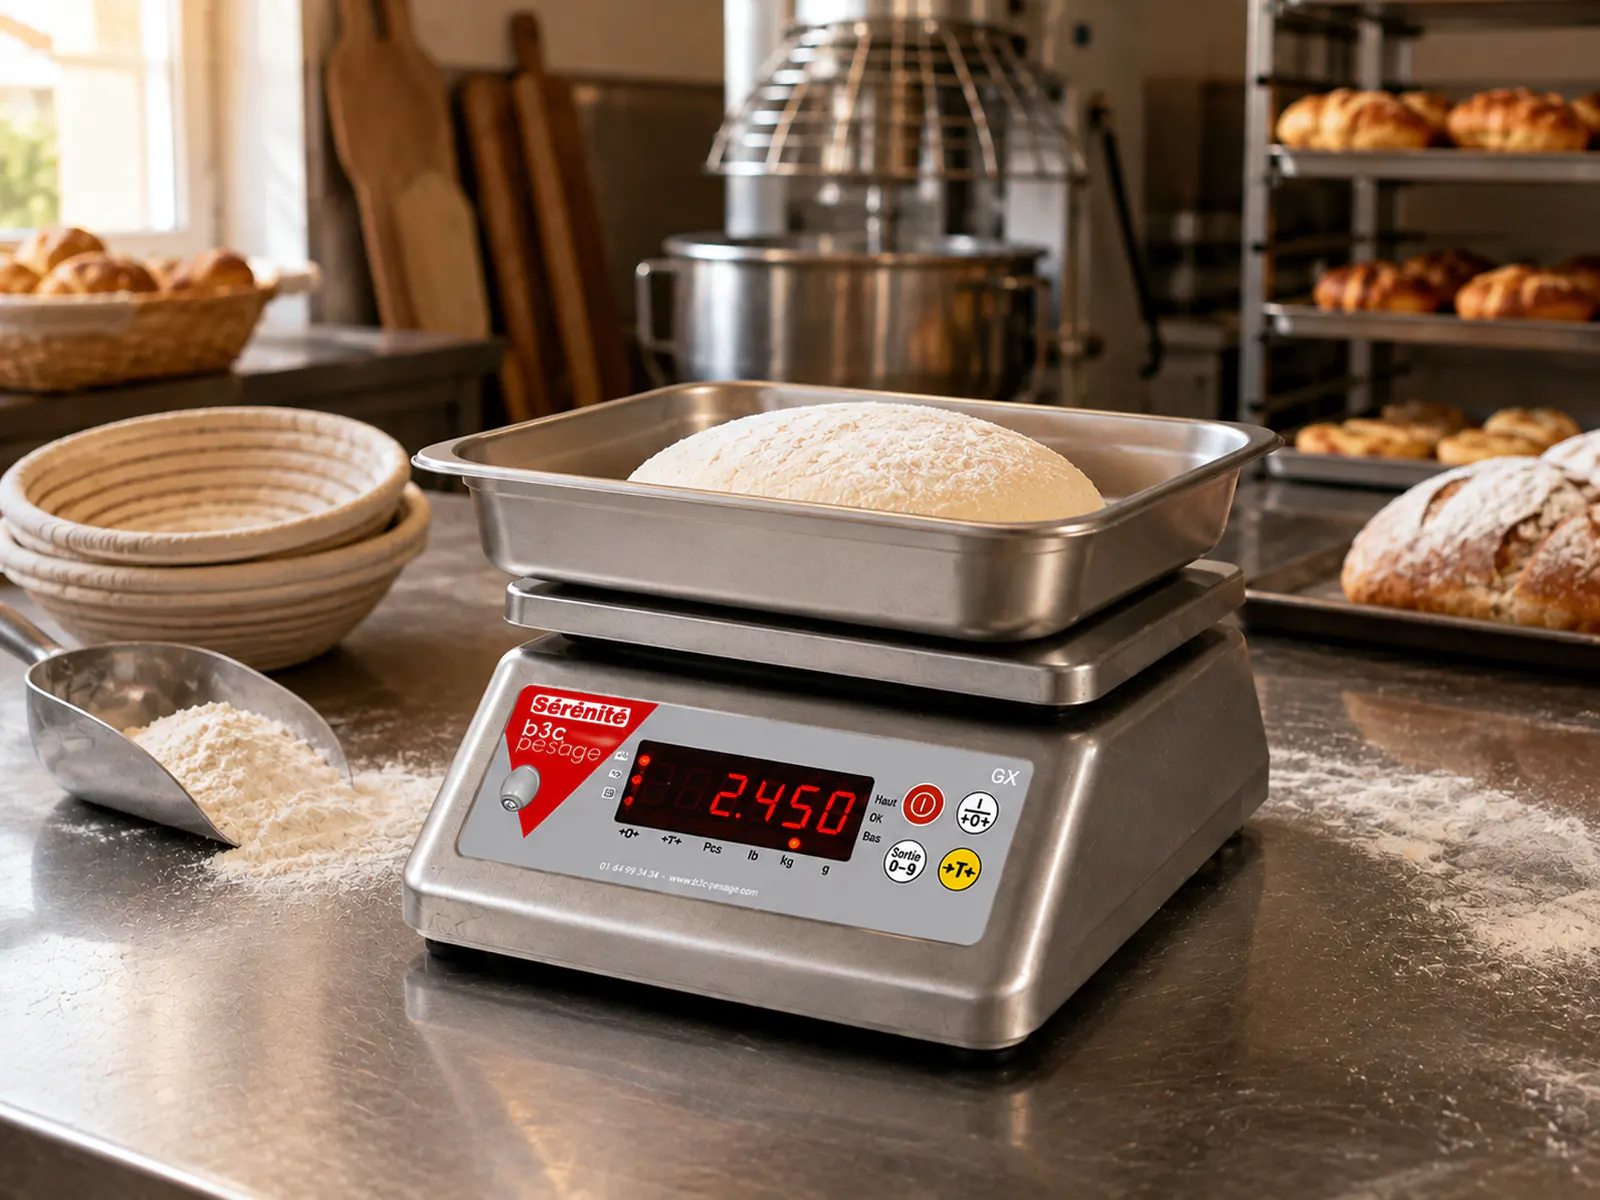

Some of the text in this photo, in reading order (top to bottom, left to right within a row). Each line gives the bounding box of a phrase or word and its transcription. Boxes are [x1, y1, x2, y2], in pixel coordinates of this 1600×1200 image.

[532, 696, 628, 725] Sérénité
[521, 719, 567, 741] b3c
[515, 737, 601, 764] pesage
[991, 768, 1020, 787] GX
[709, 773, 856, 835] 2.450
[875, 794, 898, 808] Haut
[869, 812, 884, 824] OK
[862, 831, 881, 844] Bas
[703, 842, 722, 855] Pcs
[891, 847, 921, 862] Sortie
[780, 855, 794, 869] kg
[889, 860, 916, 876] 0-9
[822, 864, 830, 876] g
